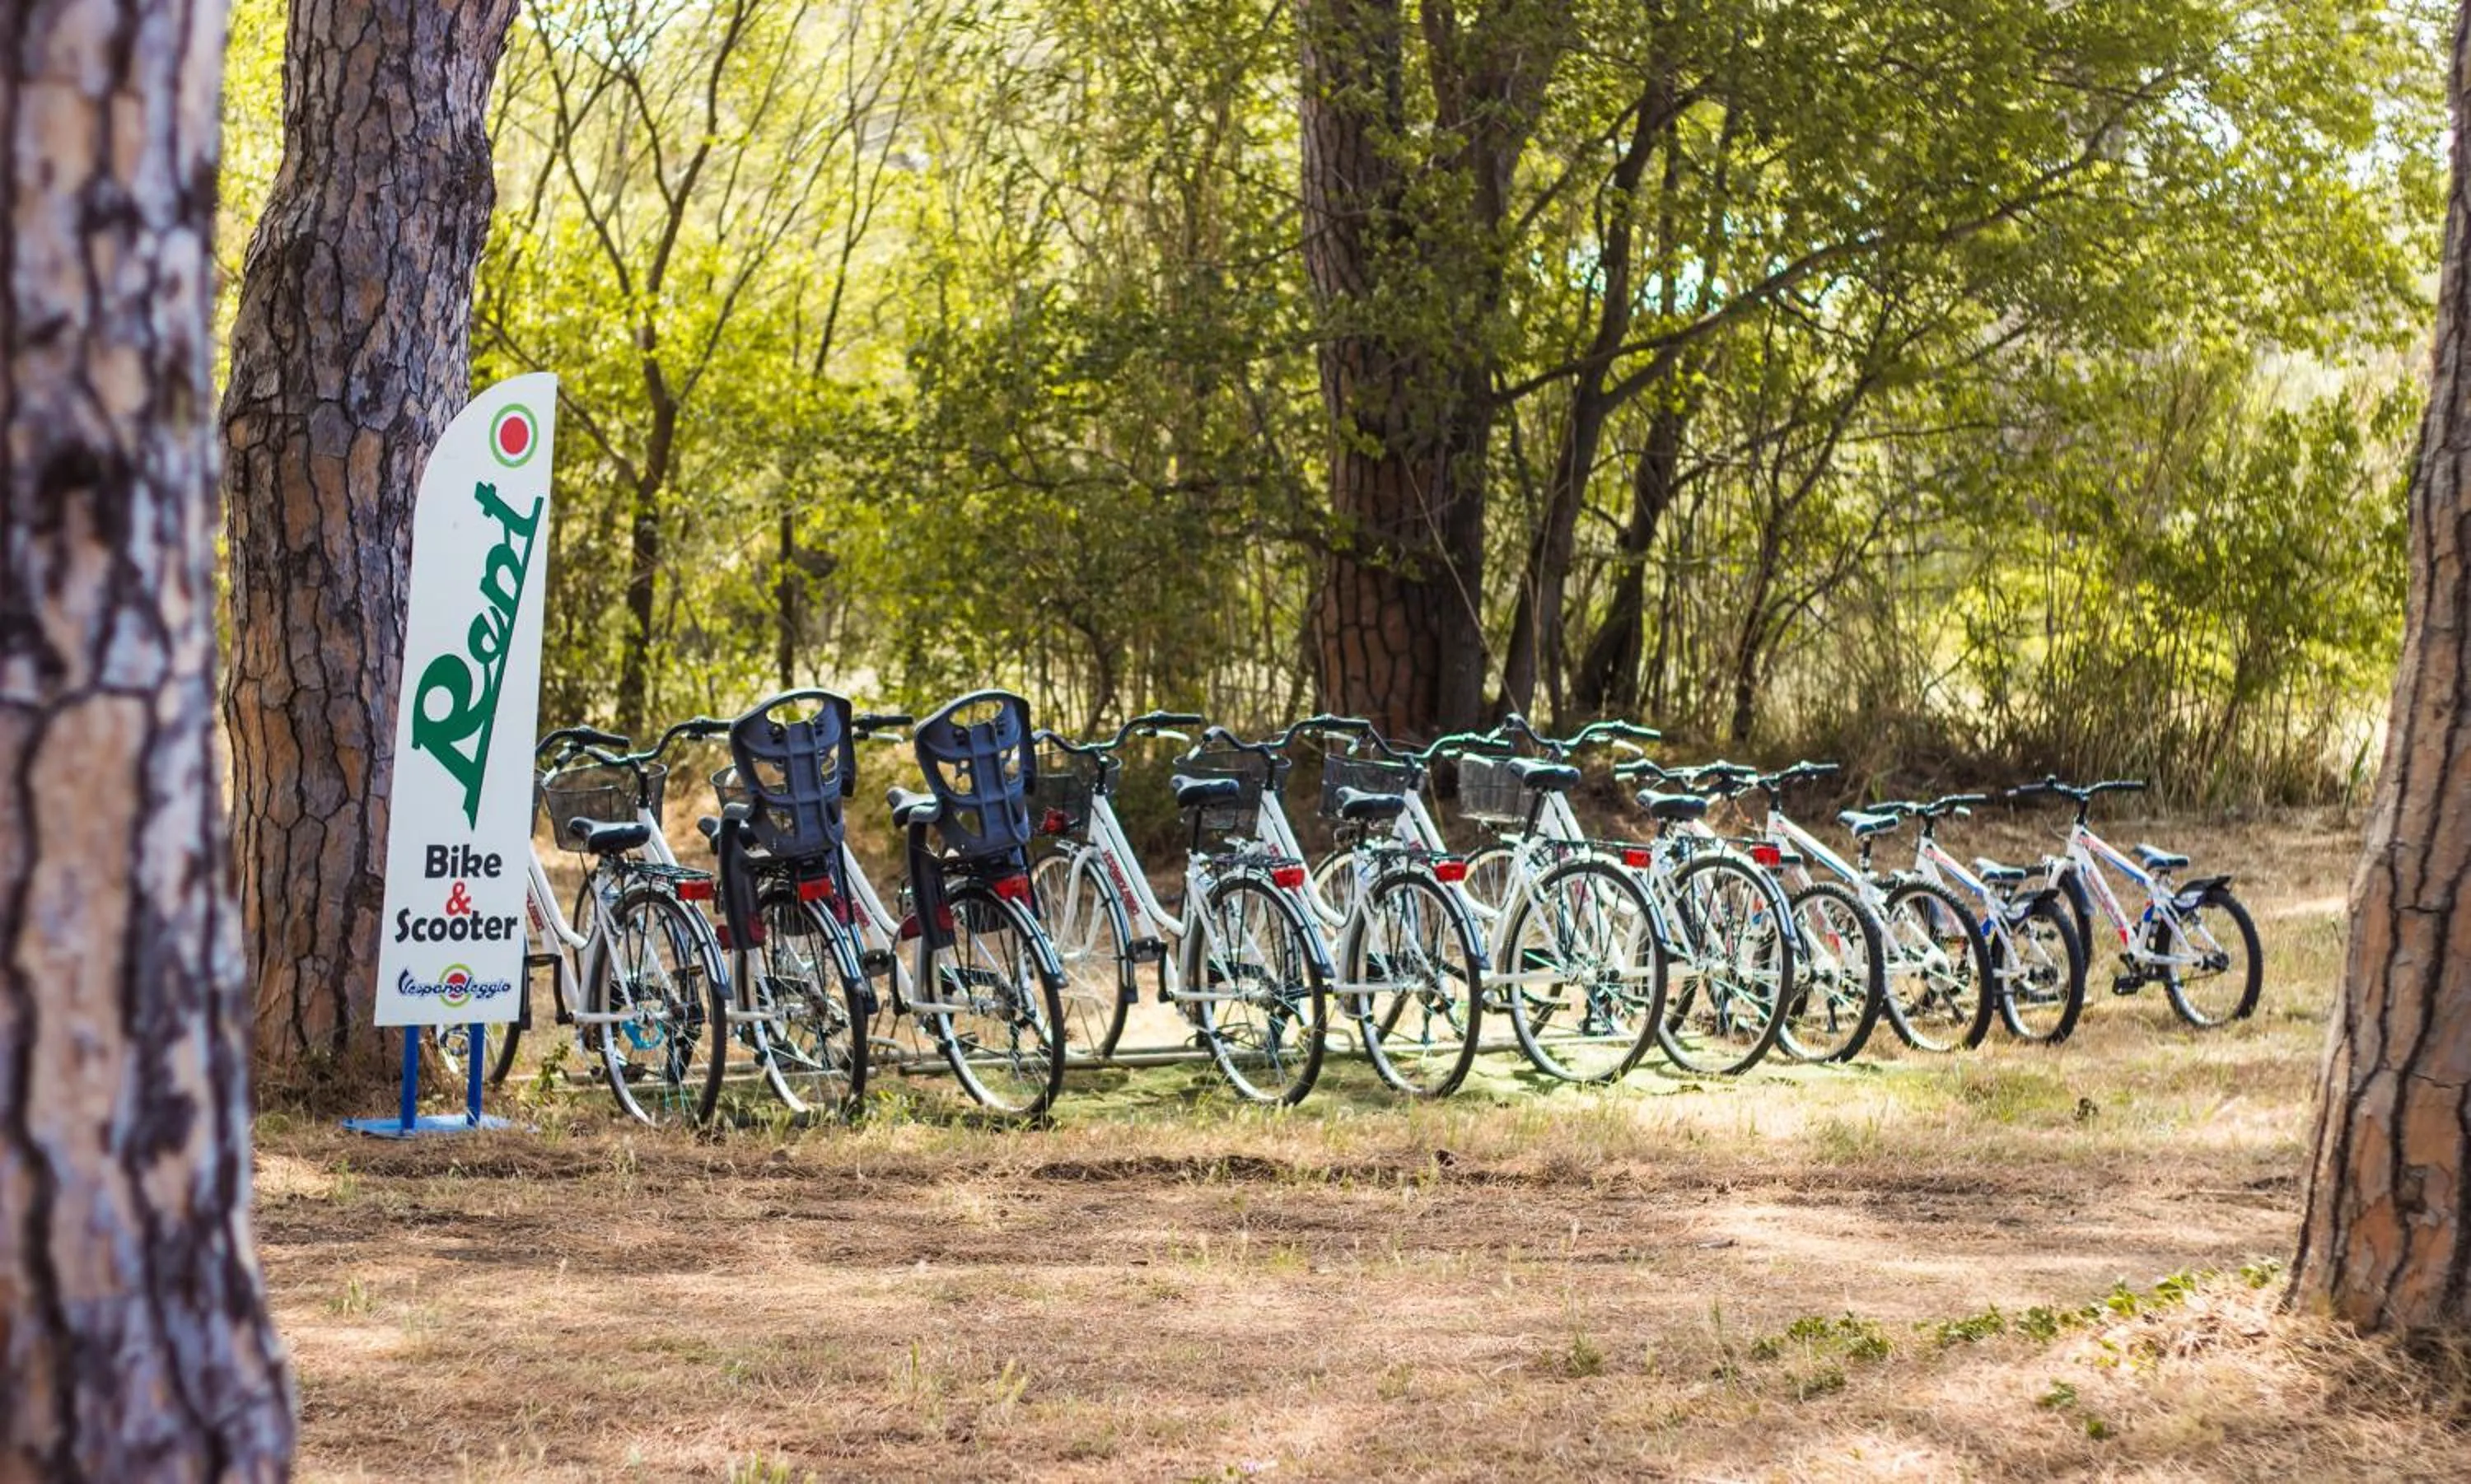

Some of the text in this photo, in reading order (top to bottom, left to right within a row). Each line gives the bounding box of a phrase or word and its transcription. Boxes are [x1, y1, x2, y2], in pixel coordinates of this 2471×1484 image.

[411, 481, 544, 832] Rent
[425, 843, 502, 878] Bike
[446, 881, 471, 916] &
[395, 908, 518, 943] Scooter
